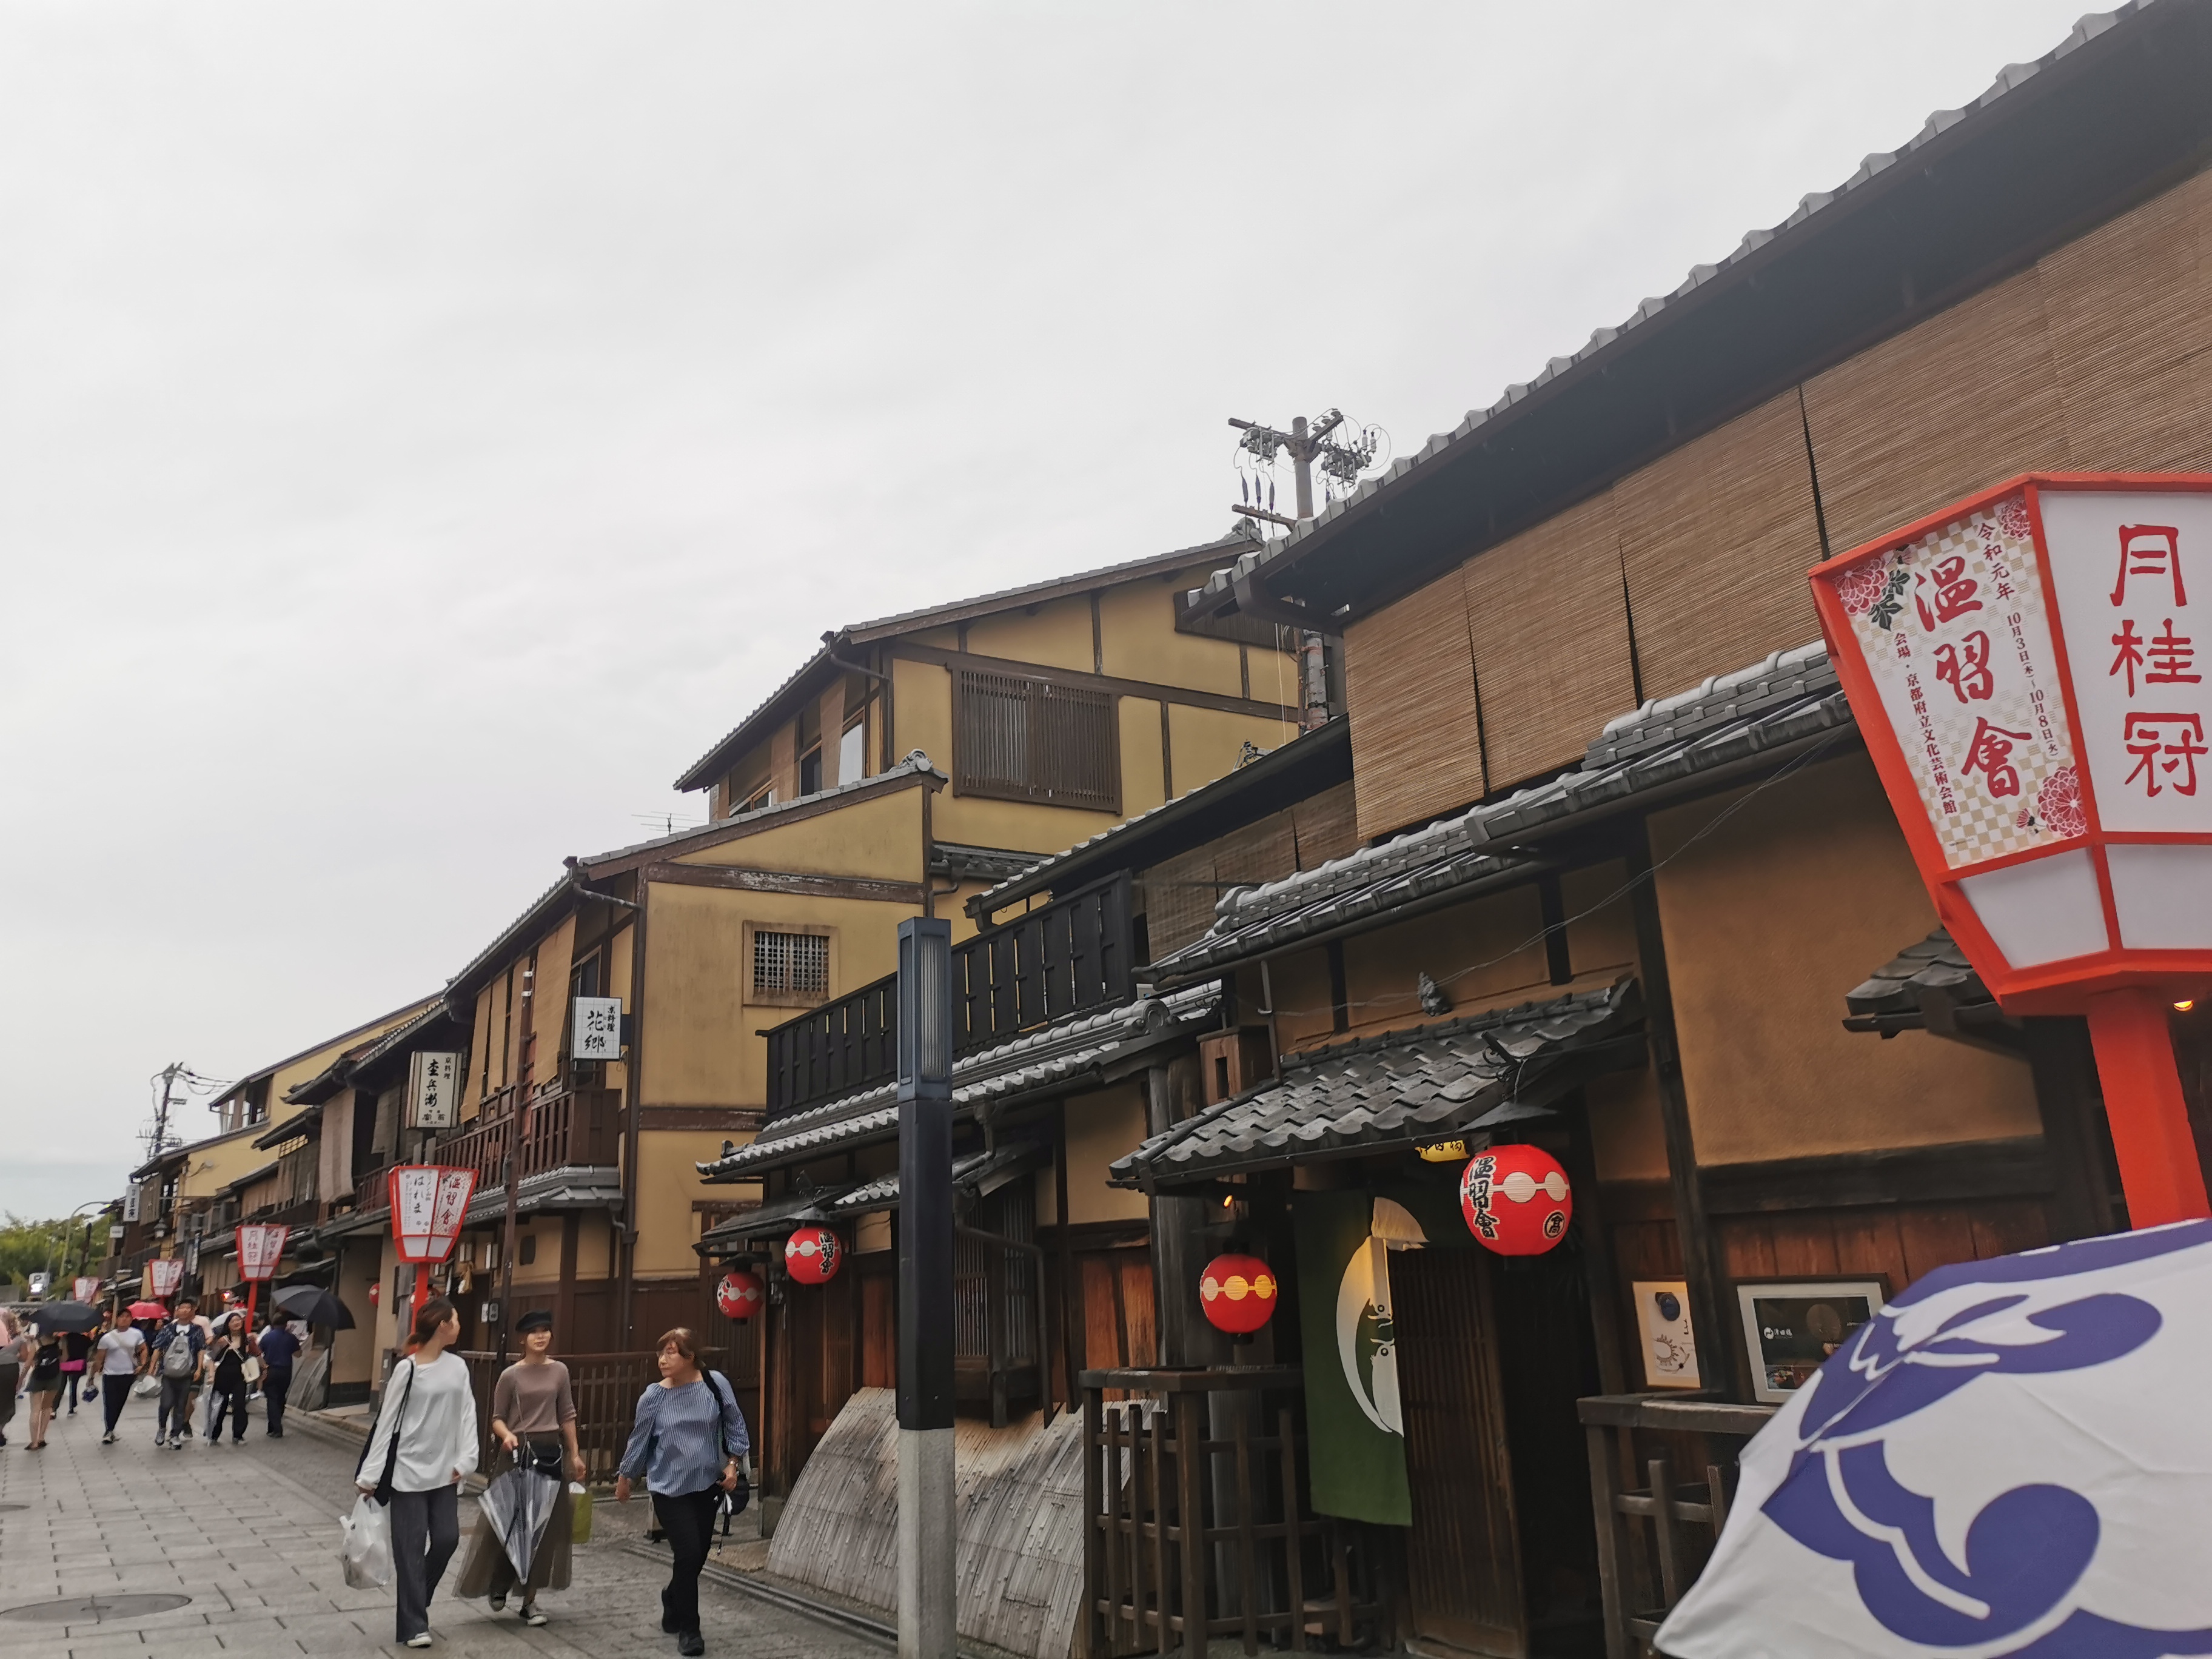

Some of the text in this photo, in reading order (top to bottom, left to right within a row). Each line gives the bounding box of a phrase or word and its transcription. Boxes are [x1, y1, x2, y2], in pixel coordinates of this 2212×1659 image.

[1977, 523, 2015, 601] 令和元年
[2109, 524, 2208, 797] 月桂冠
[607, 1005, 615, 1032] 京料理
[443, 1057, 452, 1079] 京料理
[414, 1176, 424, 1214] はれま
